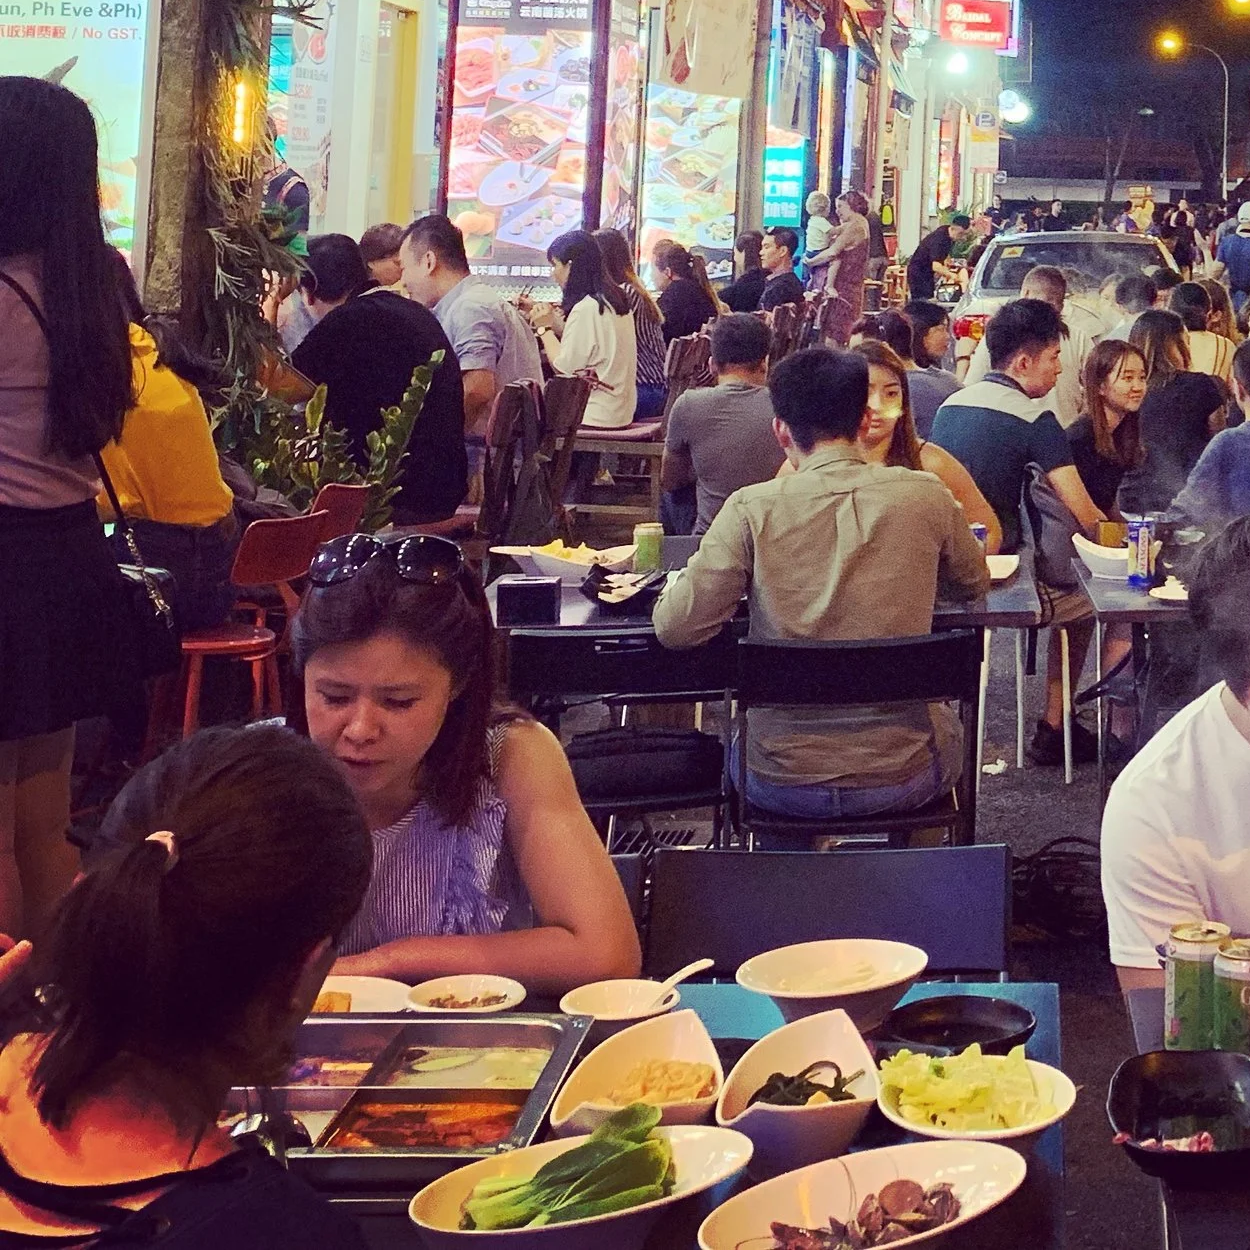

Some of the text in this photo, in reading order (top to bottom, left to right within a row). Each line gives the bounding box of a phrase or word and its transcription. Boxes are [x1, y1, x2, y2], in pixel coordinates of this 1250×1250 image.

[32, 2, 55, 17] Ph
[60, 2, 94, 17] Eve
[99, 2, 143, 19] &Ph)
[82, 27, 103, 39] No
